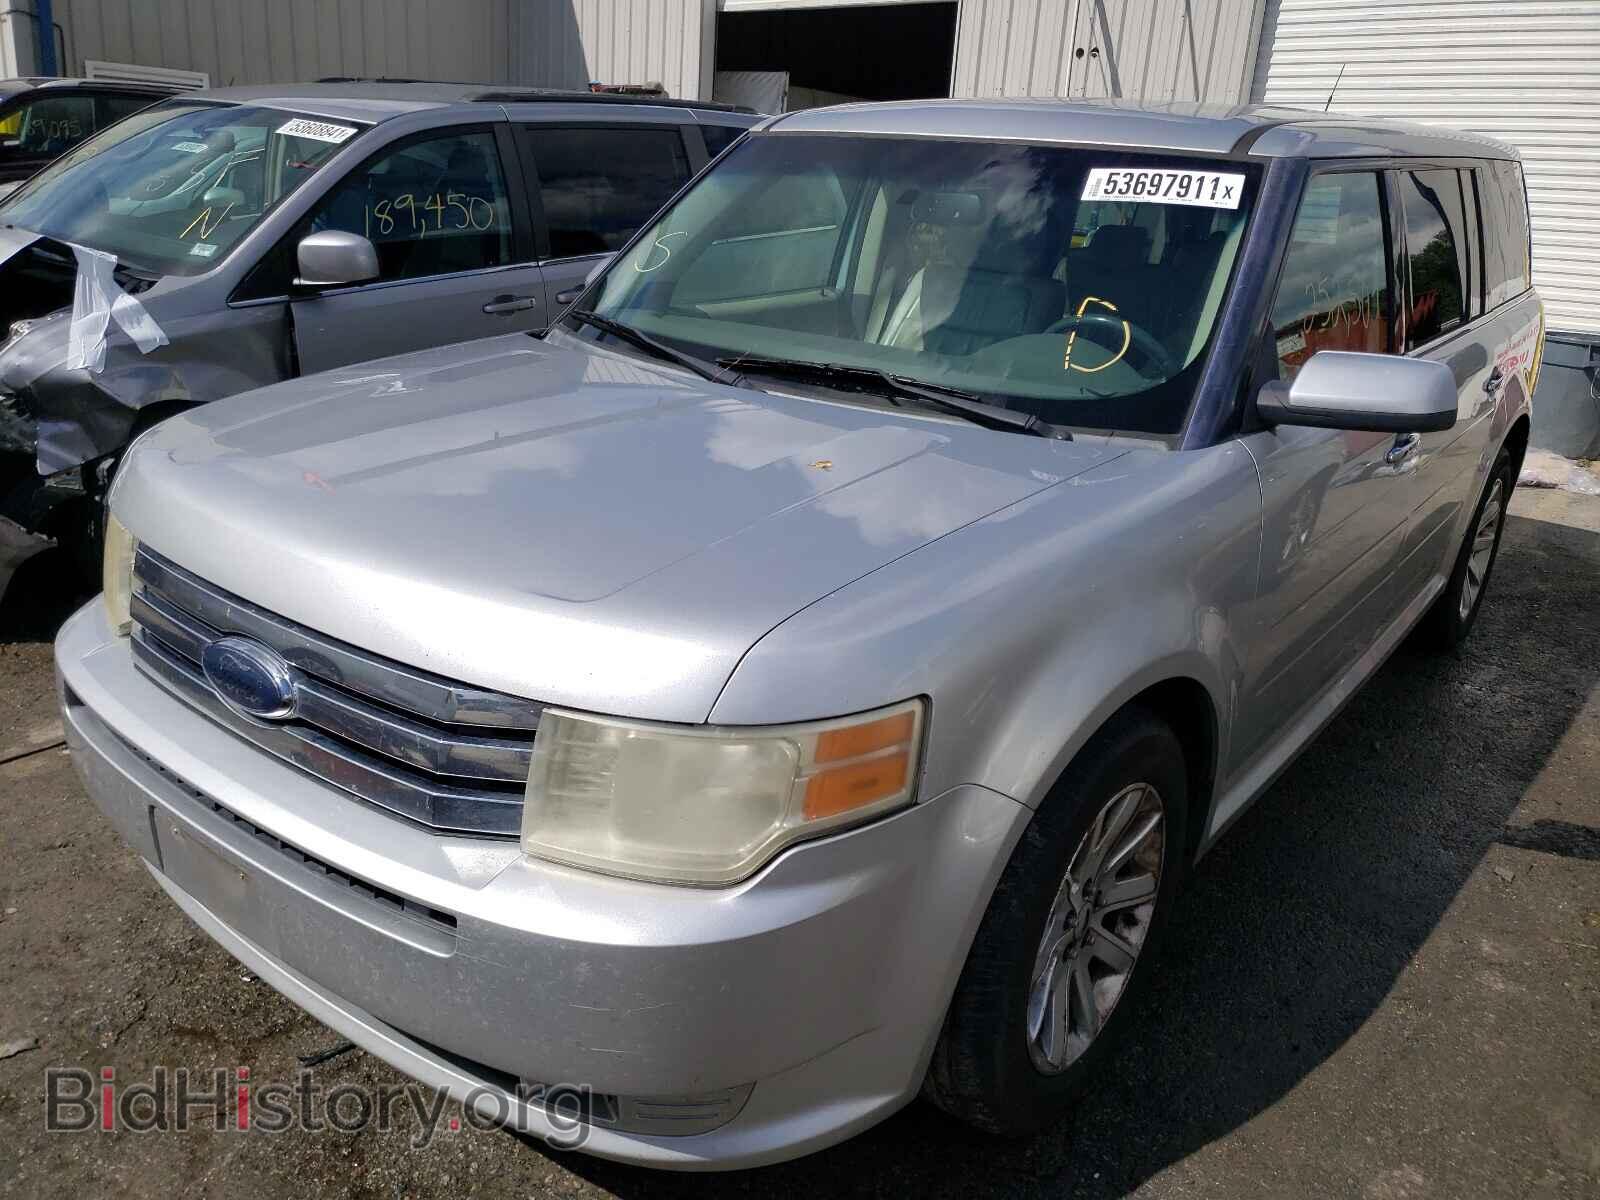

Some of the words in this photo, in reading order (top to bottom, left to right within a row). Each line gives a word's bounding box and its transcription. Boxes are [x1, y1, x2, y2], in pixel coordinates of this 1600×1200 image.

[1103, 172, 1220, 201] 53697911
[364, 192, 494, 239] 189,450
[1063, 296, 1131, 373] D
